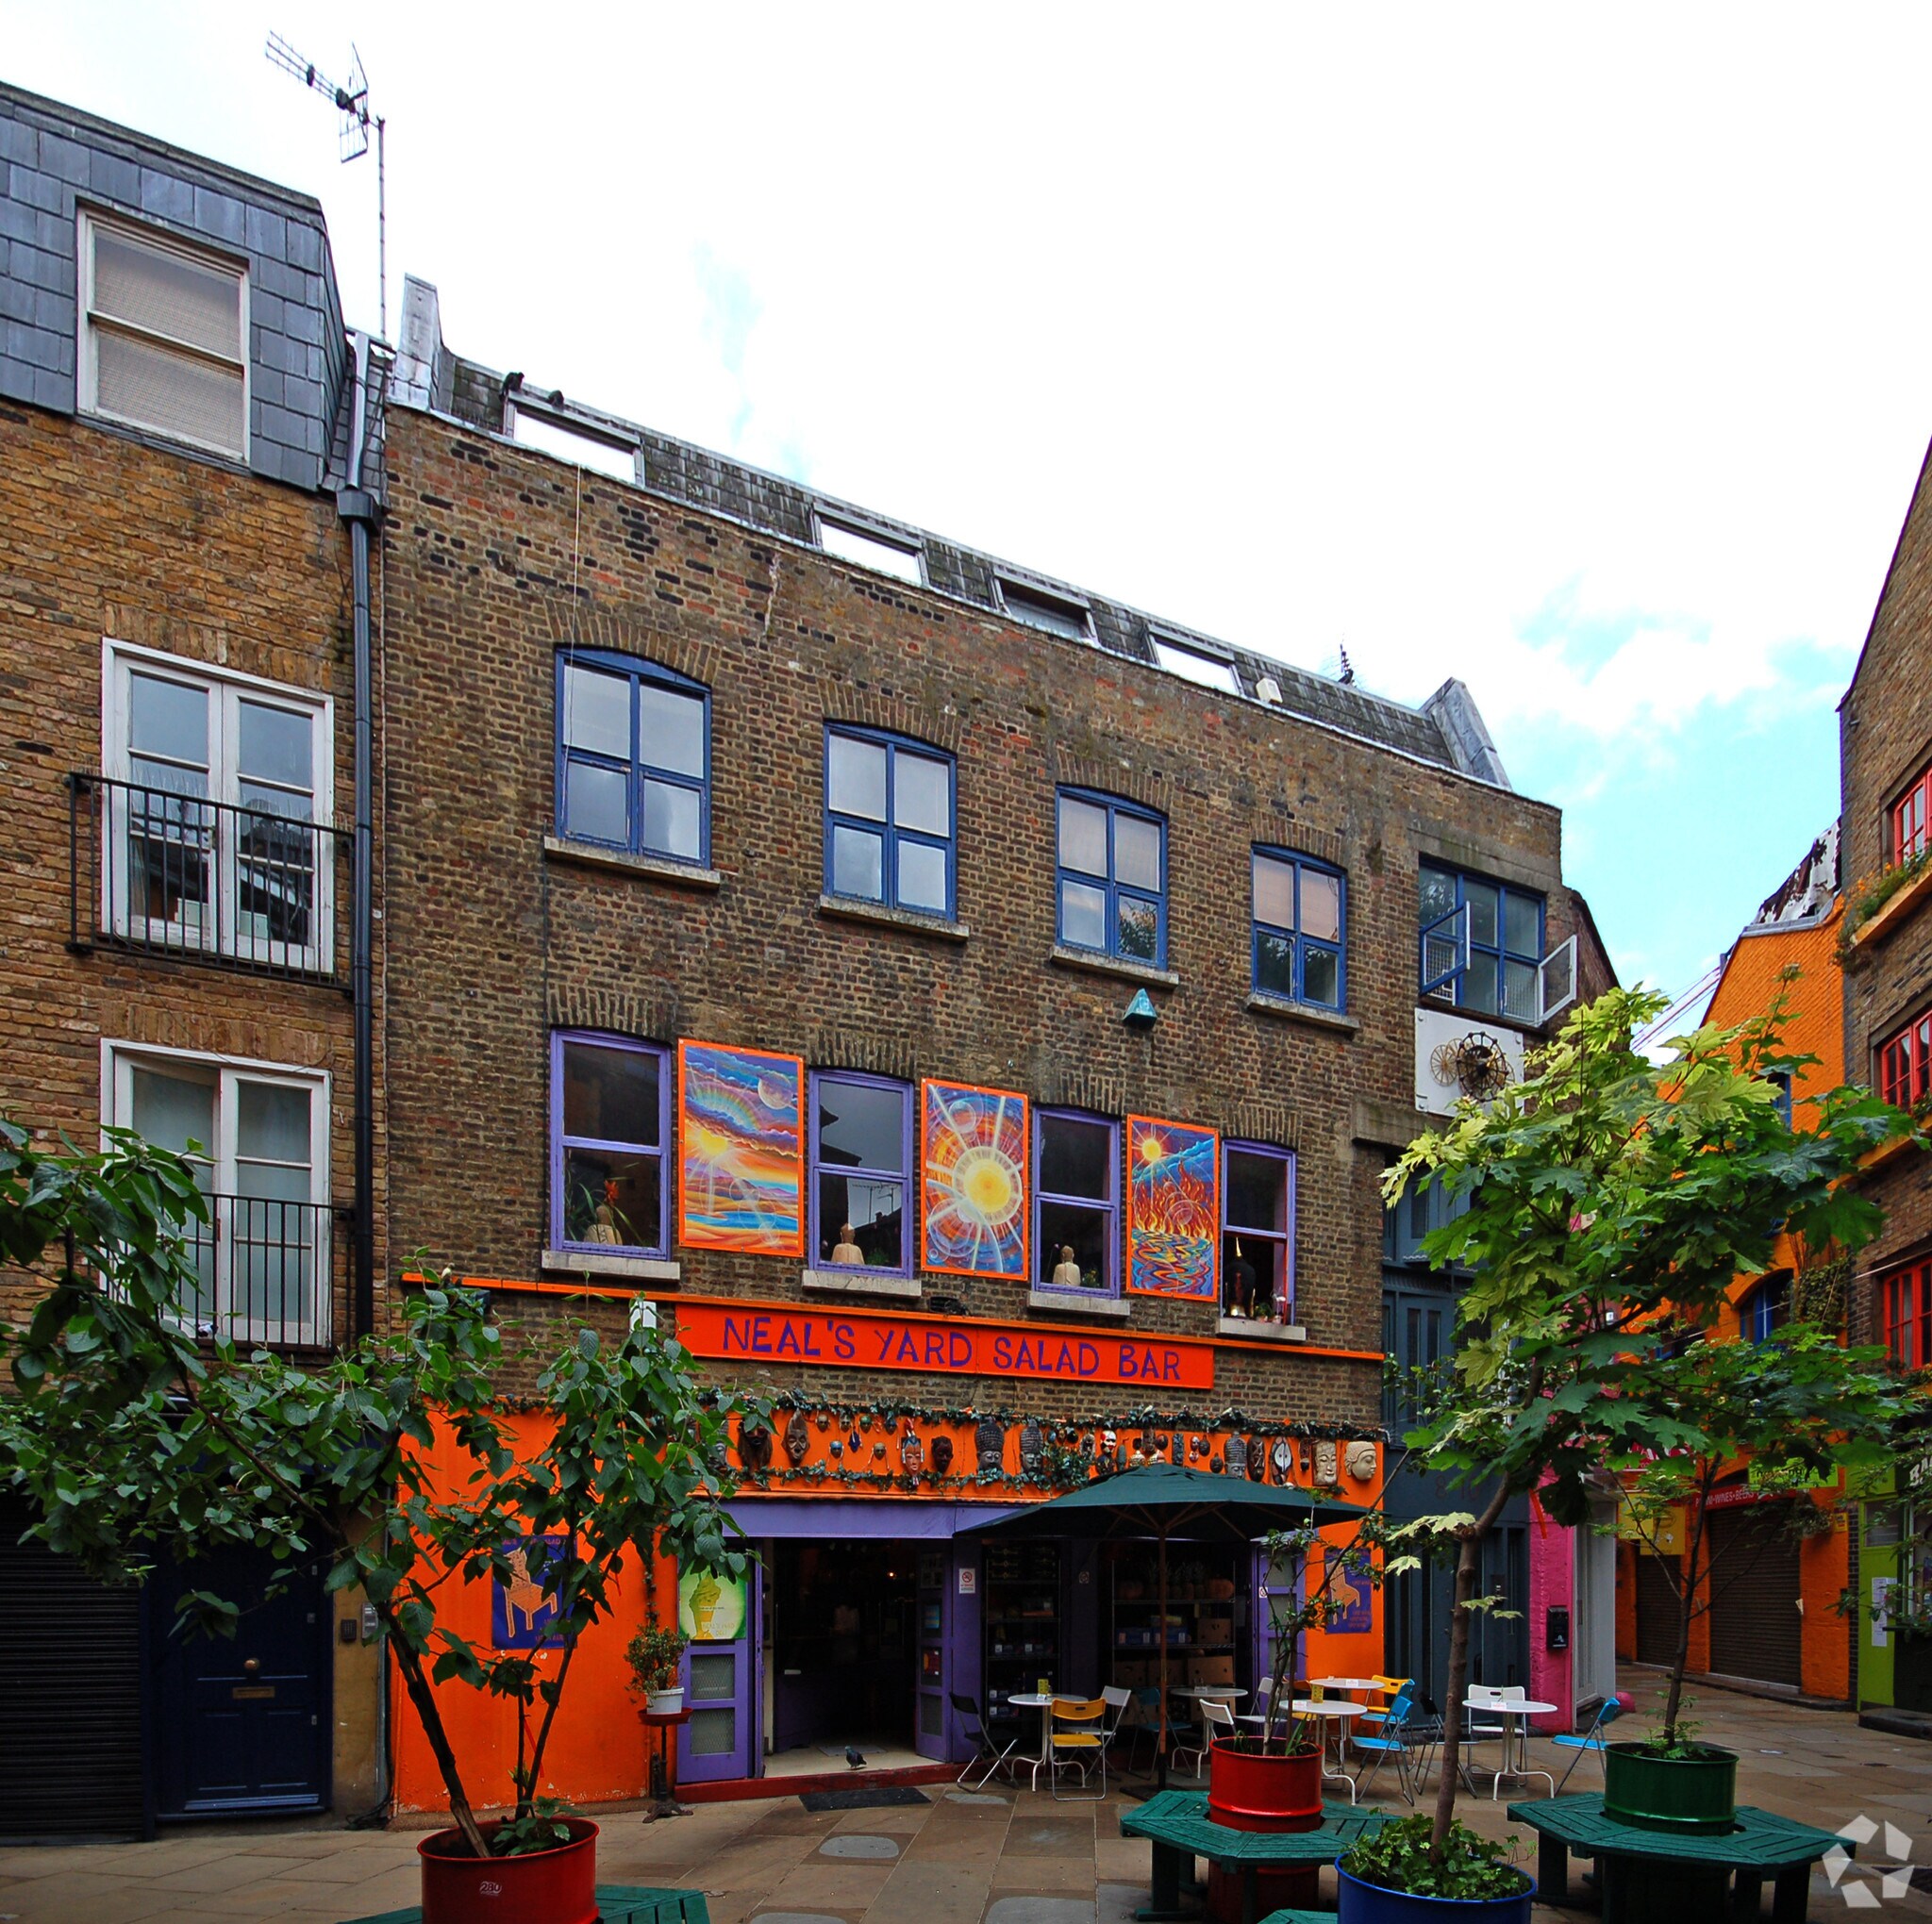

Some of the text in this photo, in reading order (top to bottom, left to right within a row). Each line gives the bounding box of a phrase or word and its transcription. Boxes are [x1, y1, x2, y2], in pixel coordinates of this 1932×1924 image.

[723, 1316, 1180, 1381] NEAL'S YARD SALAD BAR
[481, 1883, 501, 1892] 280
